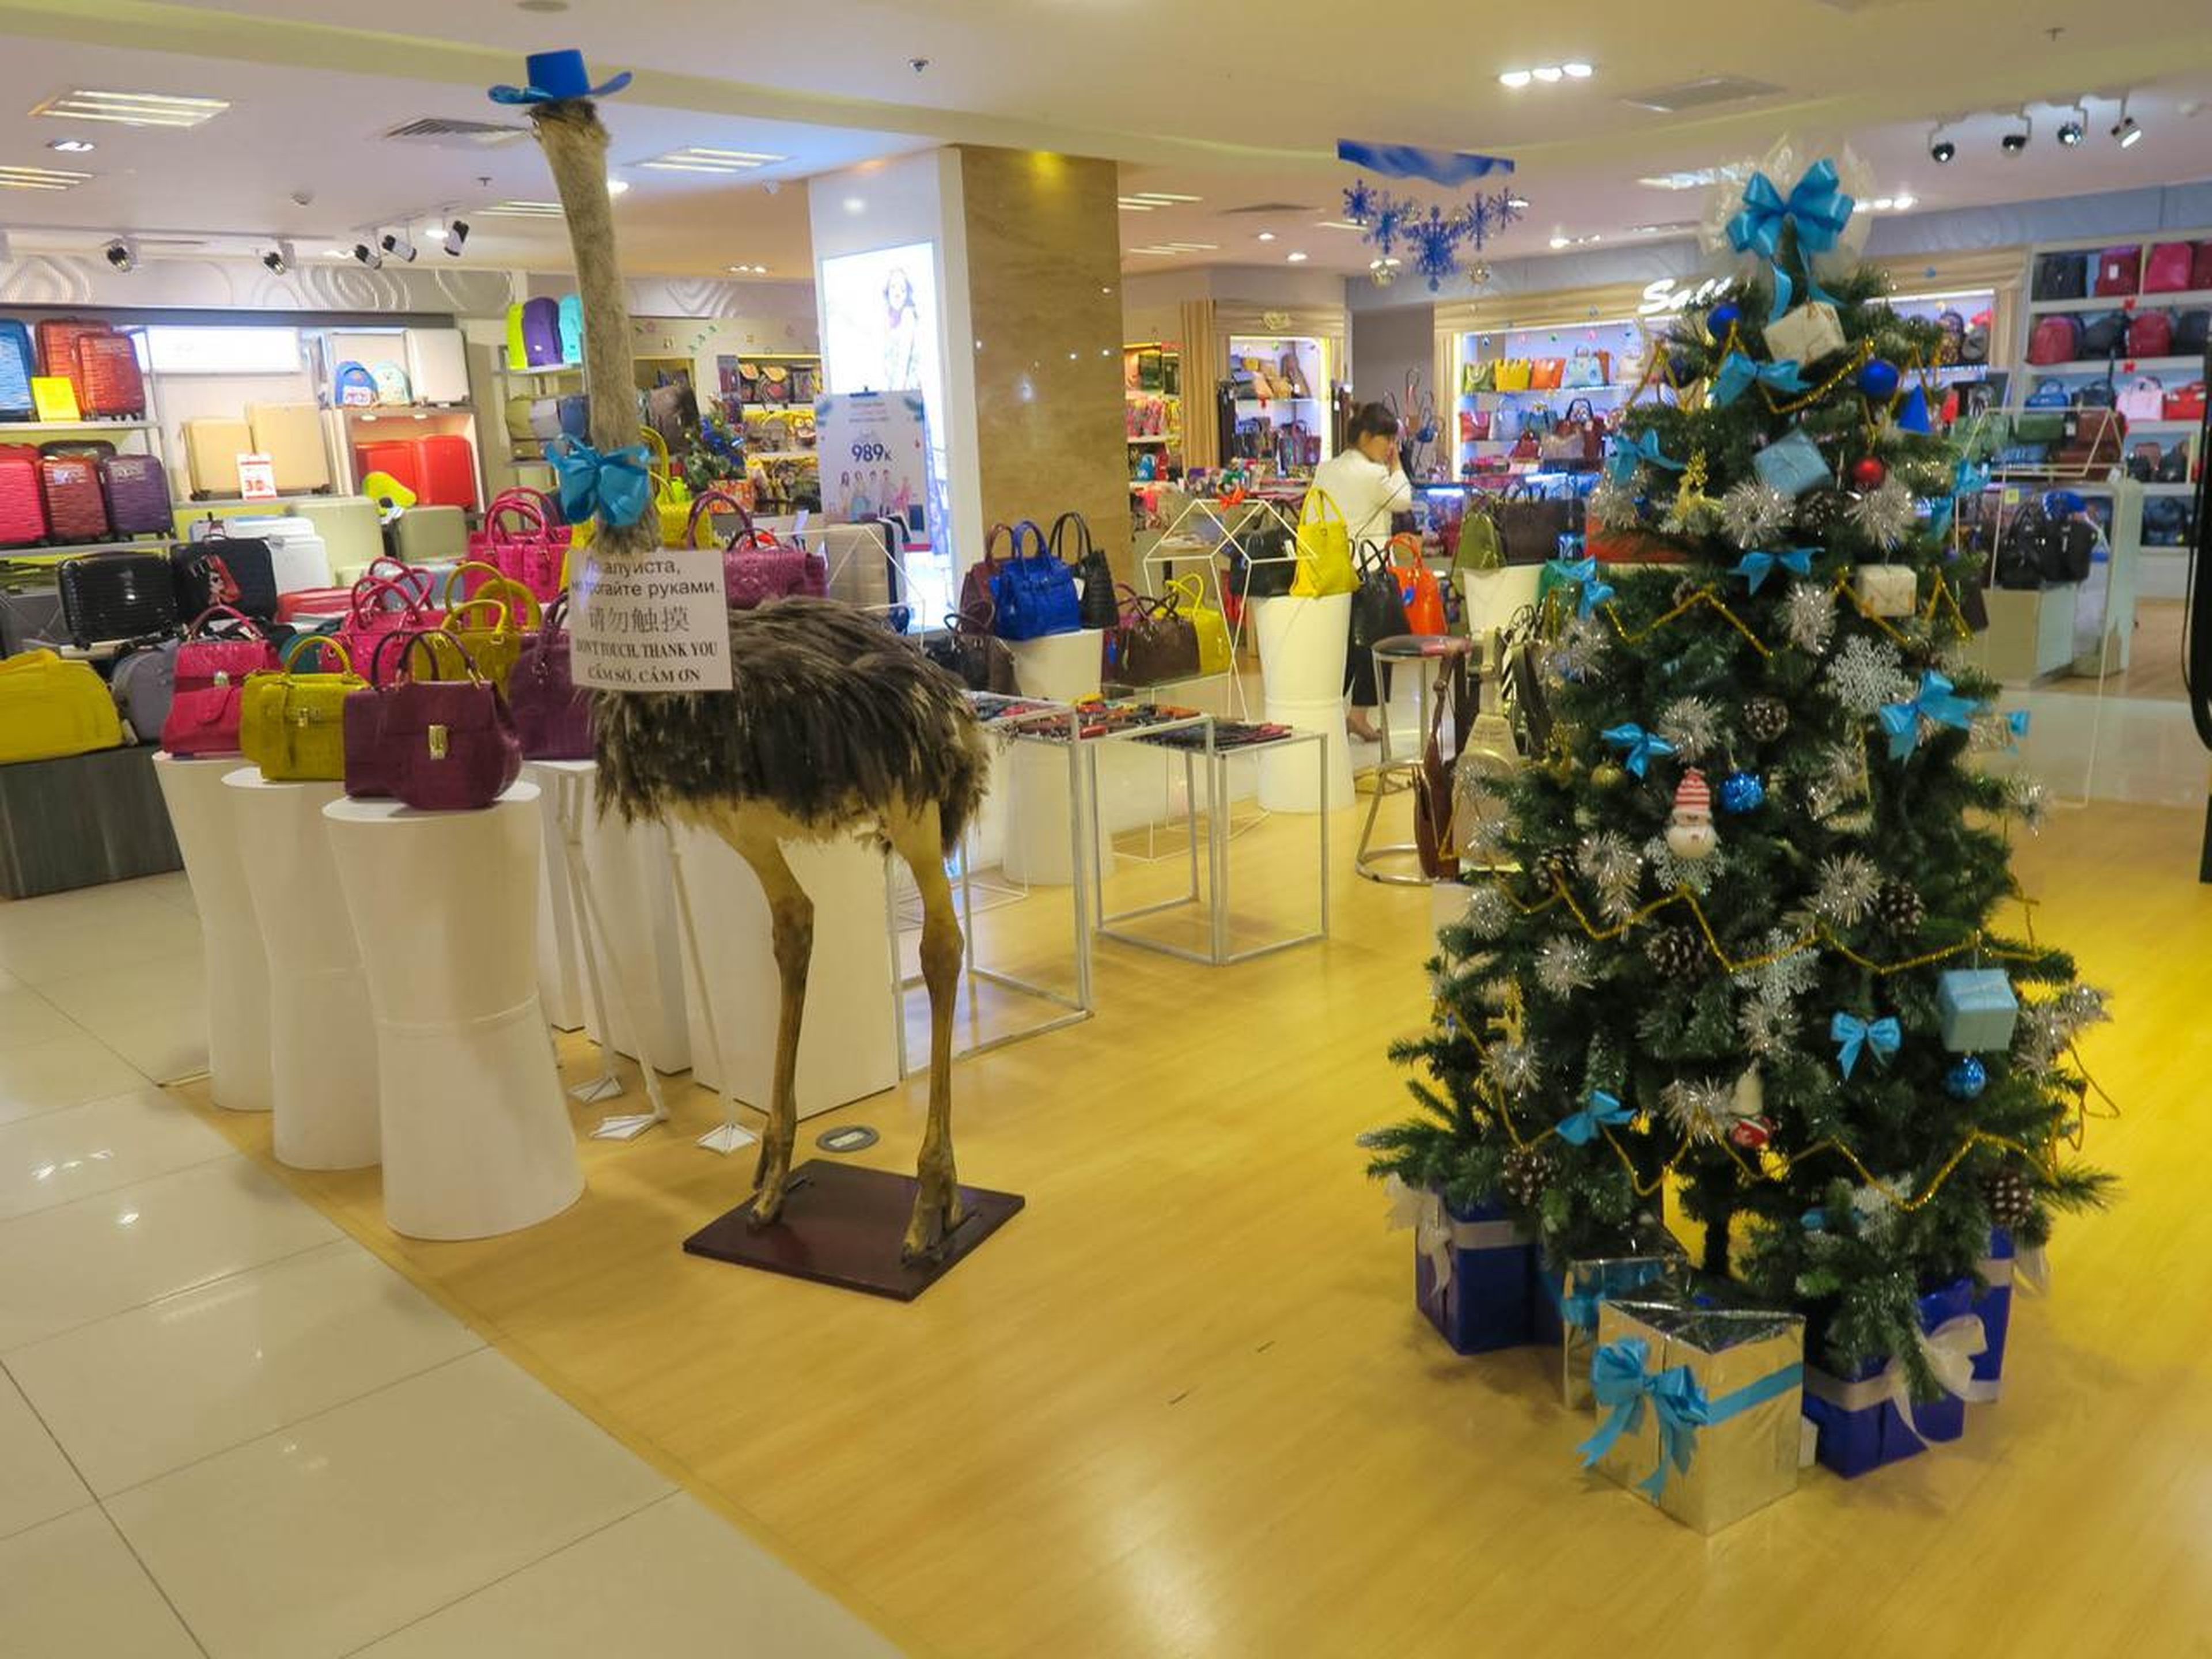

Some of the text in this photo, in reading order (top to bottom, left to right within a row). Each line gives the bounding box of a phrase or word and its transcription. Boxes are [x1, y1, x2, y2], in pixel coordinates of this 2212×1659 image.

[648, 581, 719, 599] руками.
[641, 642, 688, 658] THANK
[691, 641, 718, 657] YOU
